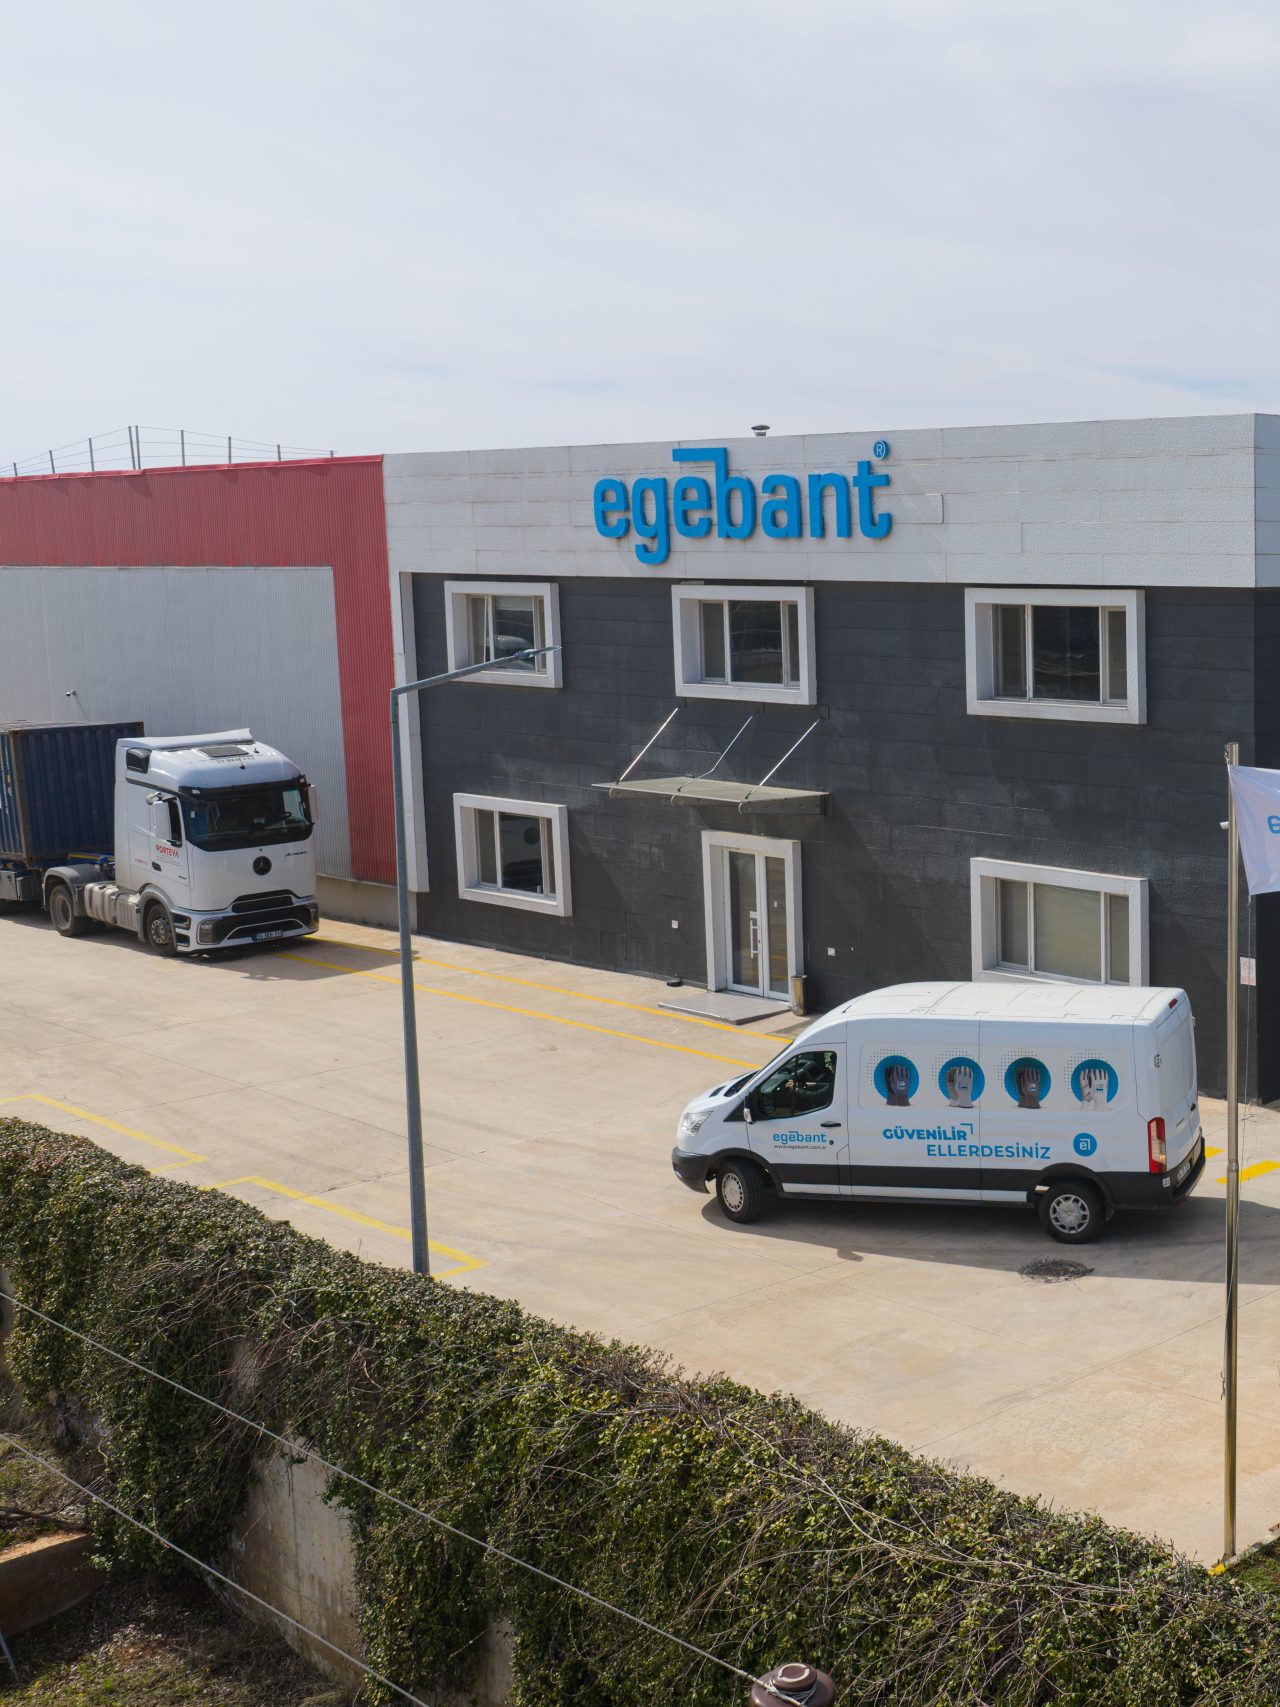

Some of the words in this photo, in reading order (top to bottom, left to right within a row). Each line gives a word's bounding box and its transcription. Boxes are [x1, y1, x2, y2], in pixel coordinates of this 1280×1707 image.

[593, 447, 893, 565] egebant
[772, 1130, 827, 1145] egebant
[882, 1125, 968, 1141] GÜVENİLİR
[926, 1142, 1051, 1160] ELLERDESİNİZ
